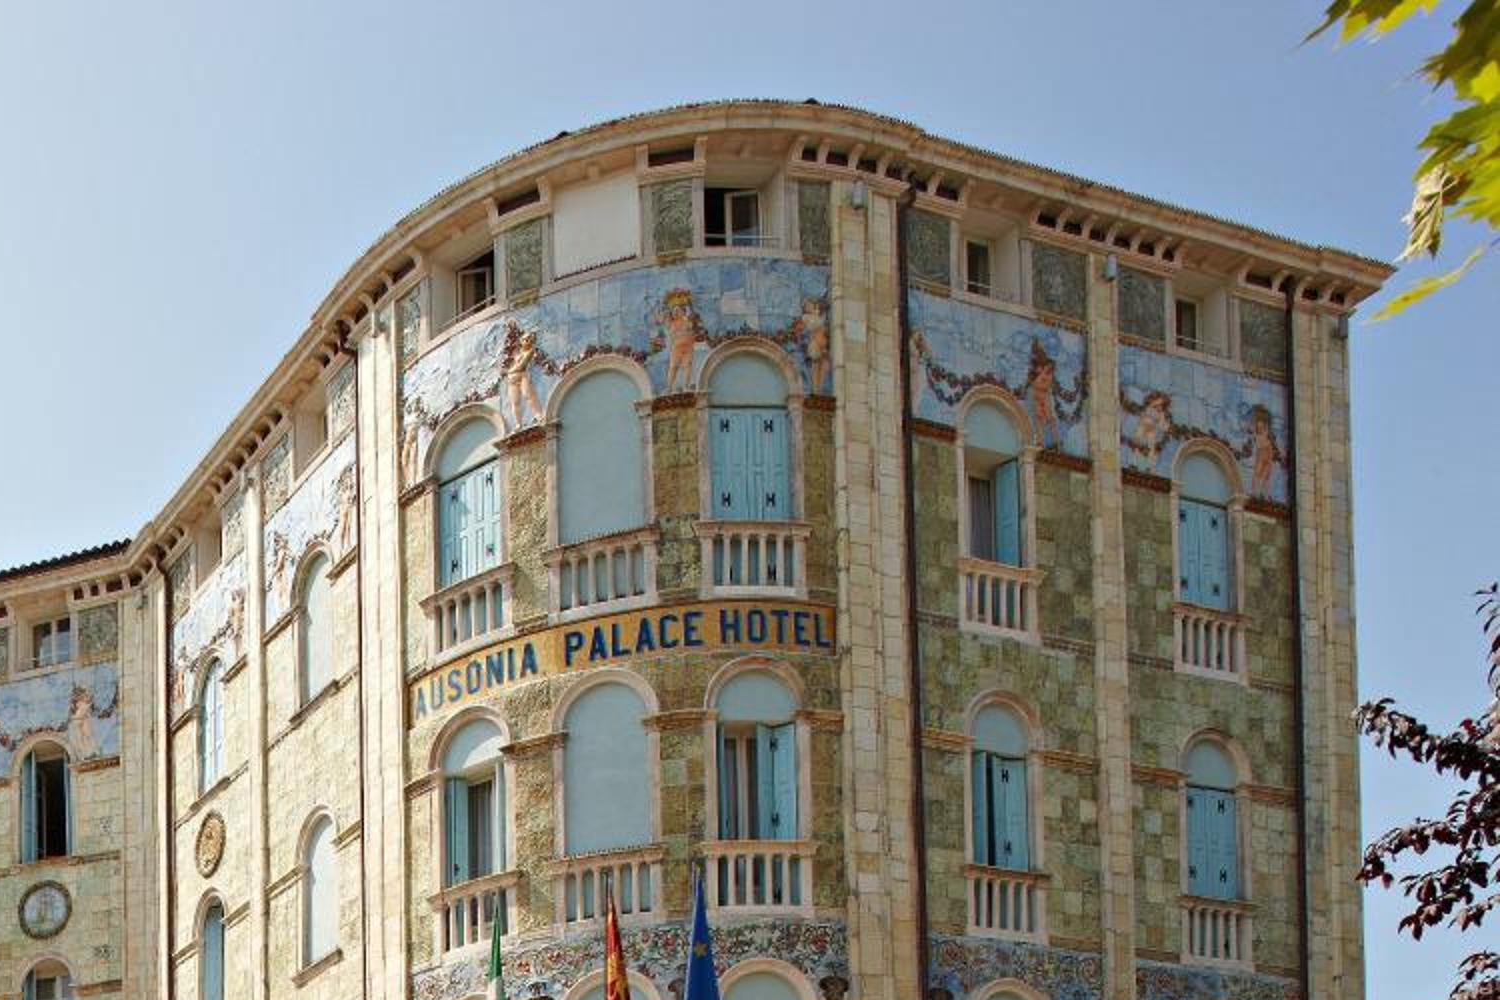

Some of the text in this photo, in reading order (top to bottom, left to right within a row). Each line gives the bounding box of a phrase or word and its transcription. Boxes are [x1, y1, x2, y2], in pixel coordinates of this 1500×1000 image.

[414, 608, 832, 721] AUSONIA PALACE HOTEL
